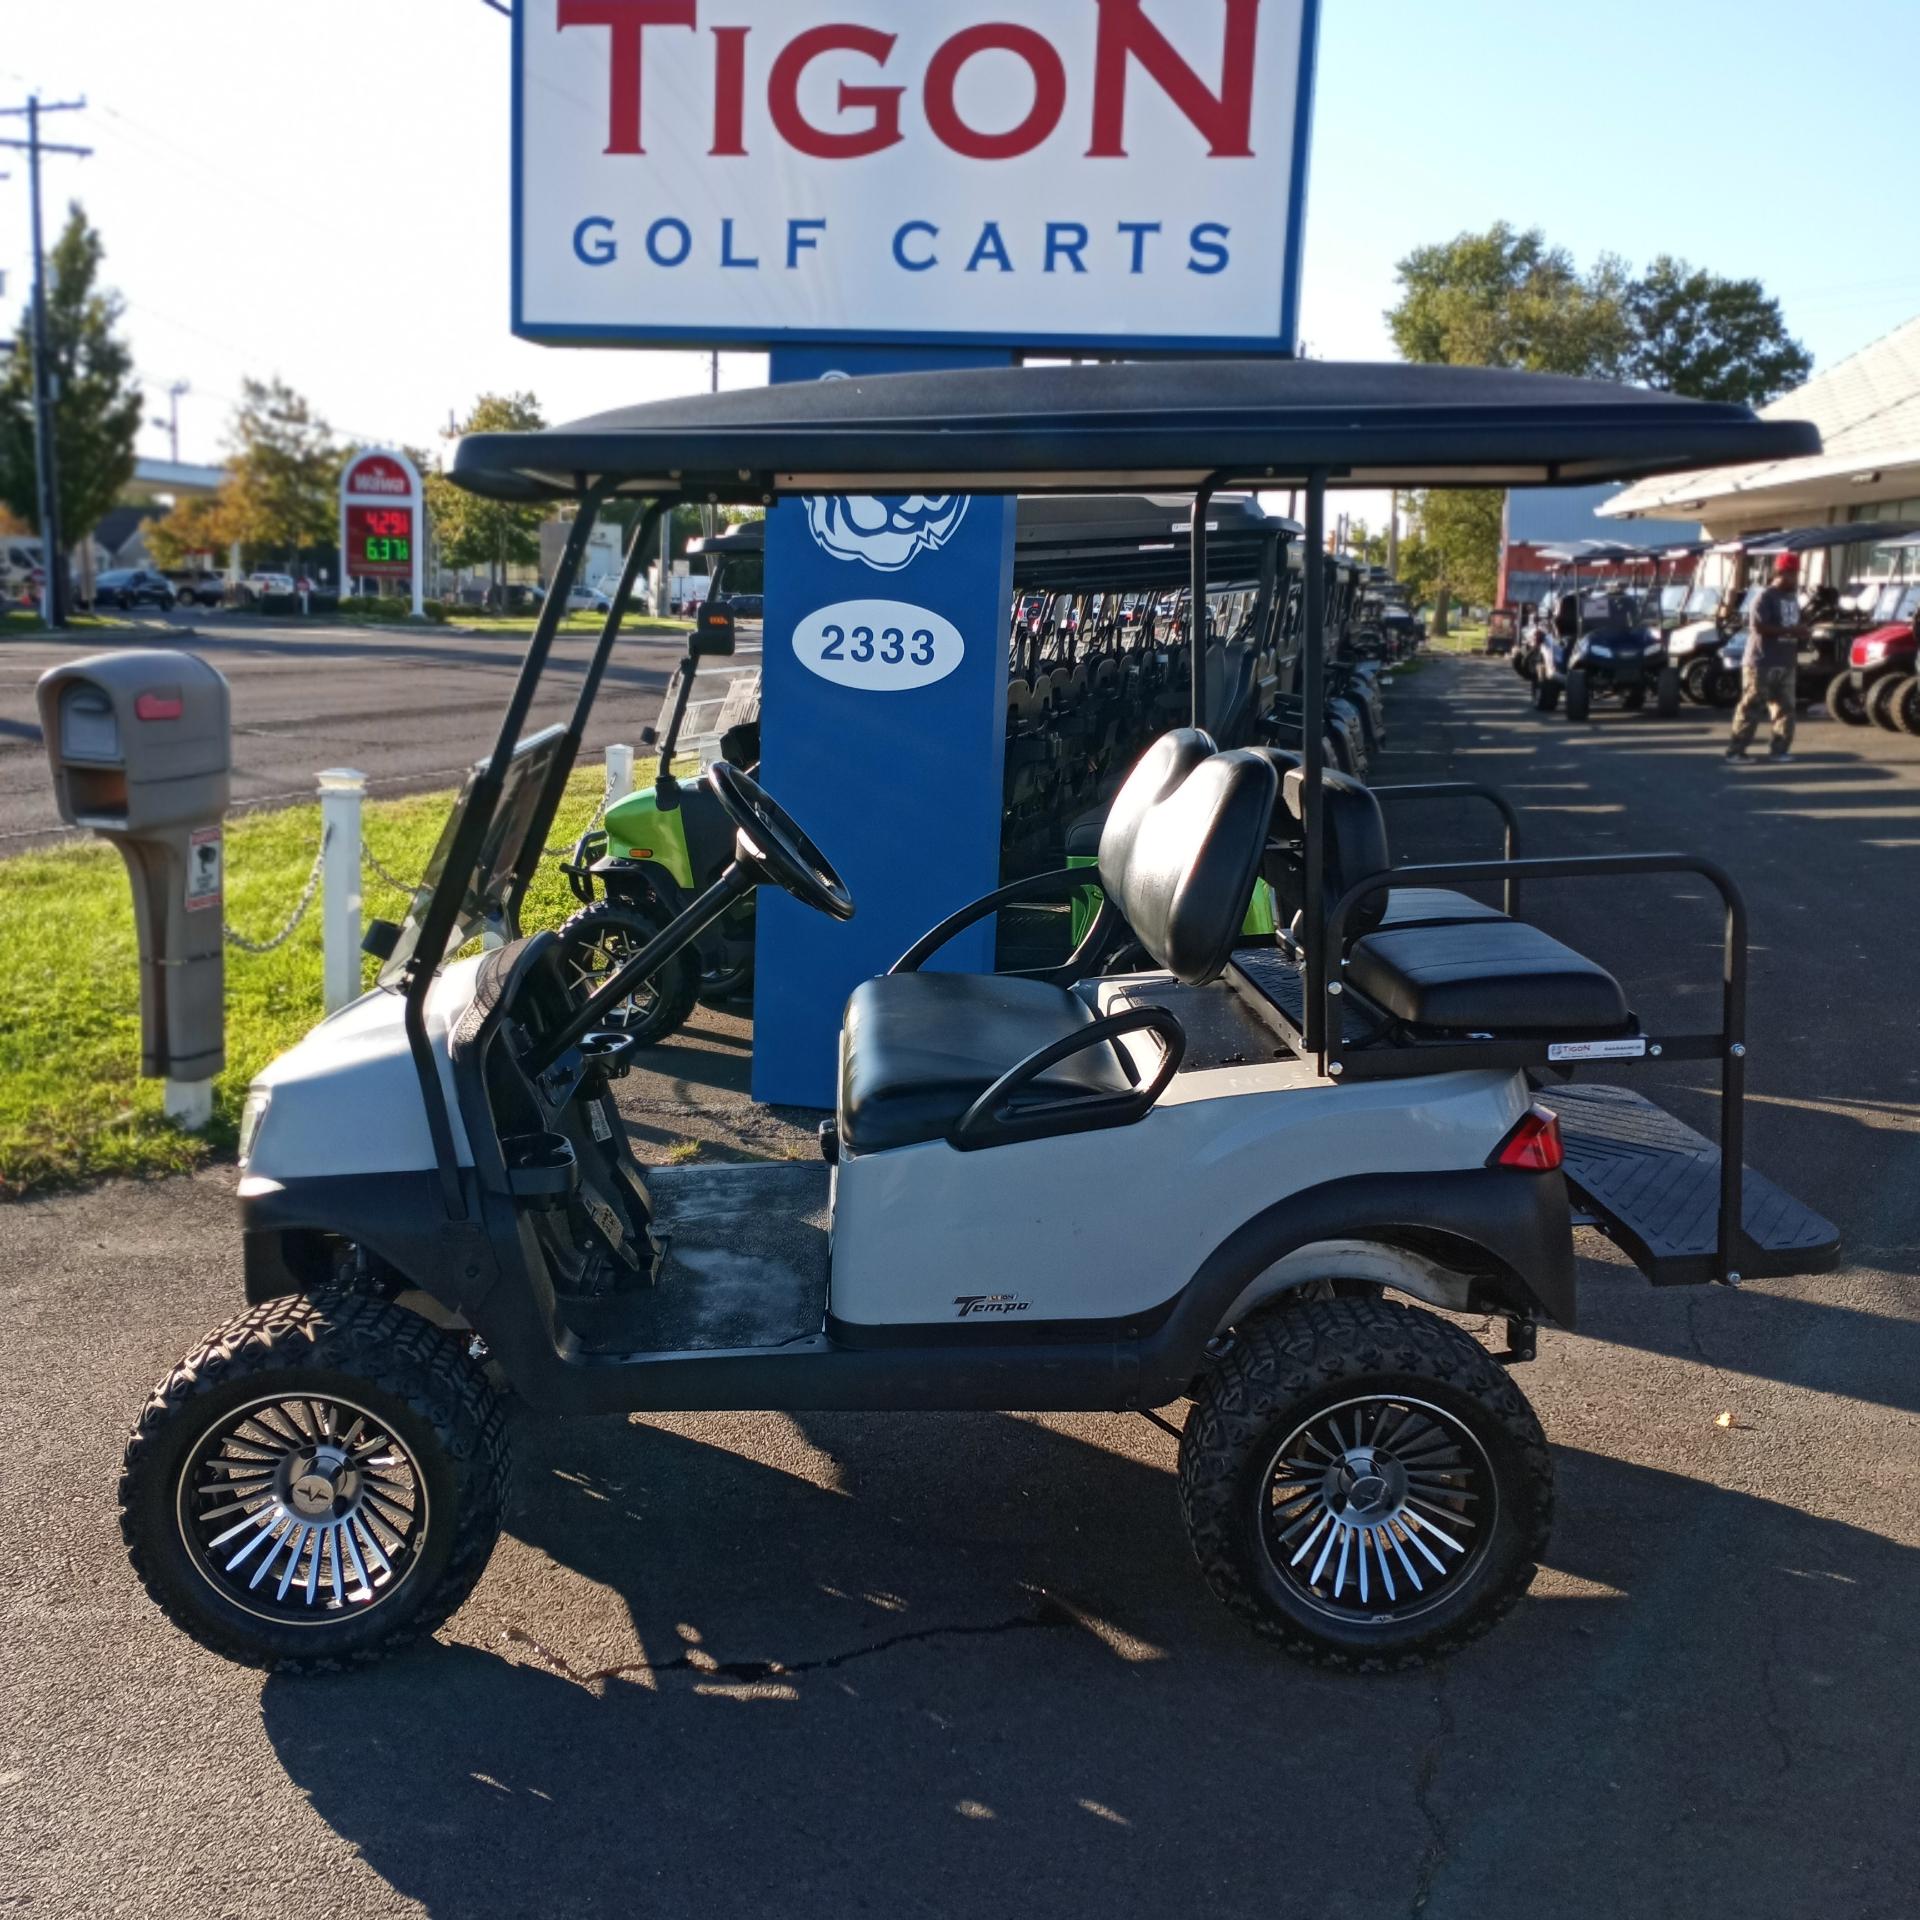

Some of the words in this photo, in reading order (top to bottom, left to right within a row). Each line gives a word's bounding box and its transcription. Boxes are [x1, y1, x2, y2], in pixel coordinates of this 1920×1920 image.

[557, 0, 1260, 160] TIGON
[572, 215, 827, 270] GOLF
[891, 219, 1232, 275] CARTS
[820, 624, 935, 666] 2333
[952, 1294, 1031, 1318] Tempo
